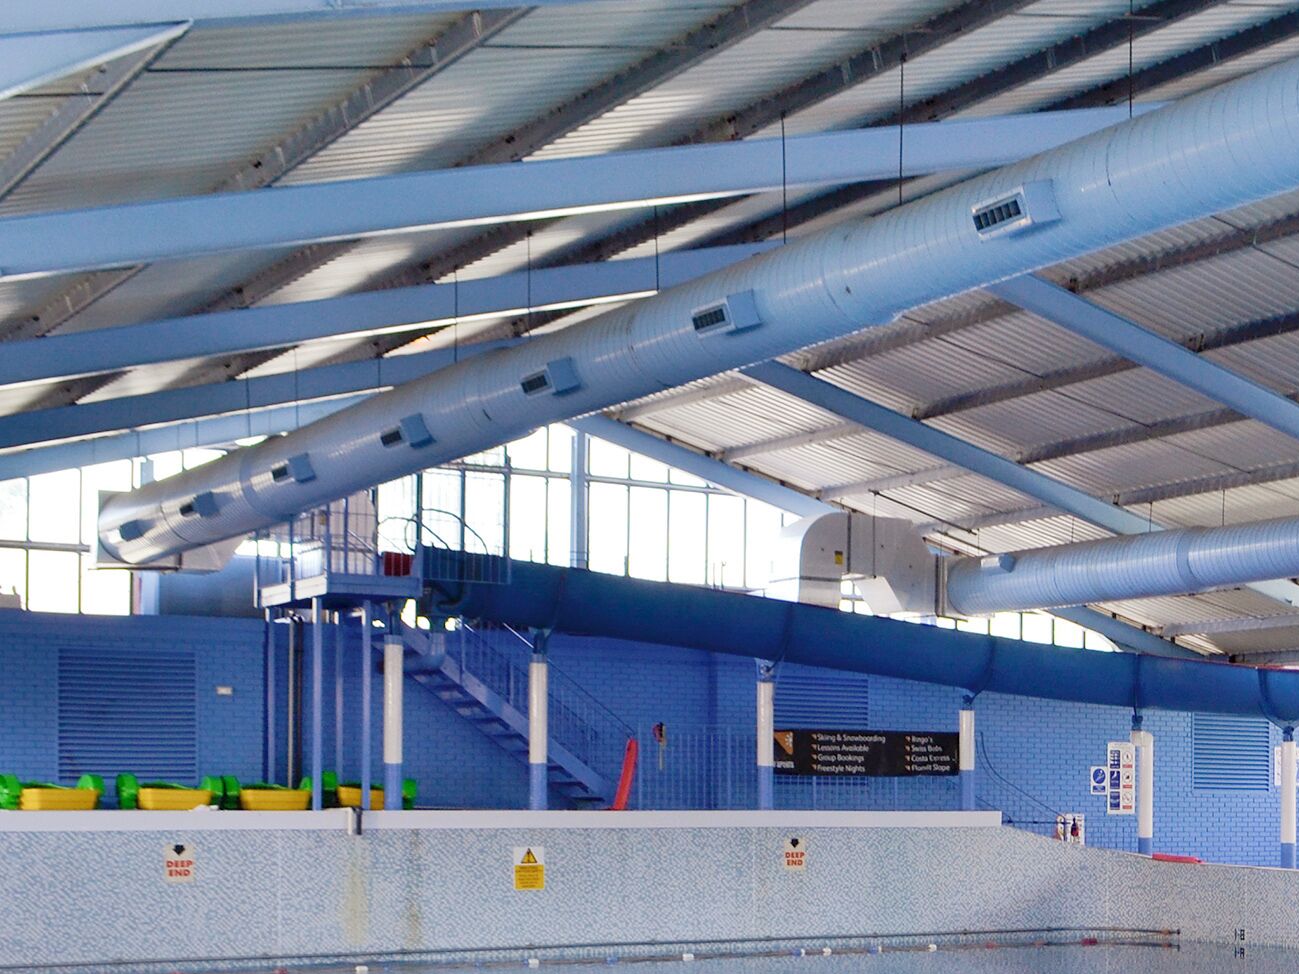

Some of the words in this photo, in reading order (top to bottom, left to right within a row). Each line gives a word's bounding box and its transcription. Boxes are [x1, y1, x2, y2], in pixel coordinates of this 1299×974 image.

[817, 733, 836, 743] Skiing
[842, 734, 886, 744] Snowboarding
[817, 744, 840, 752] Lessons
[841, 744, 869, 752] Available
[817, 754, 837, 762] Group
[836, 754, 865, 763] Bookings
[817, 764, 844, 773] Freestyle
[844, 765, 866, 773] Nights
[166, 860, 193, 868] DEEP
[168, 869, 190, 877] END
